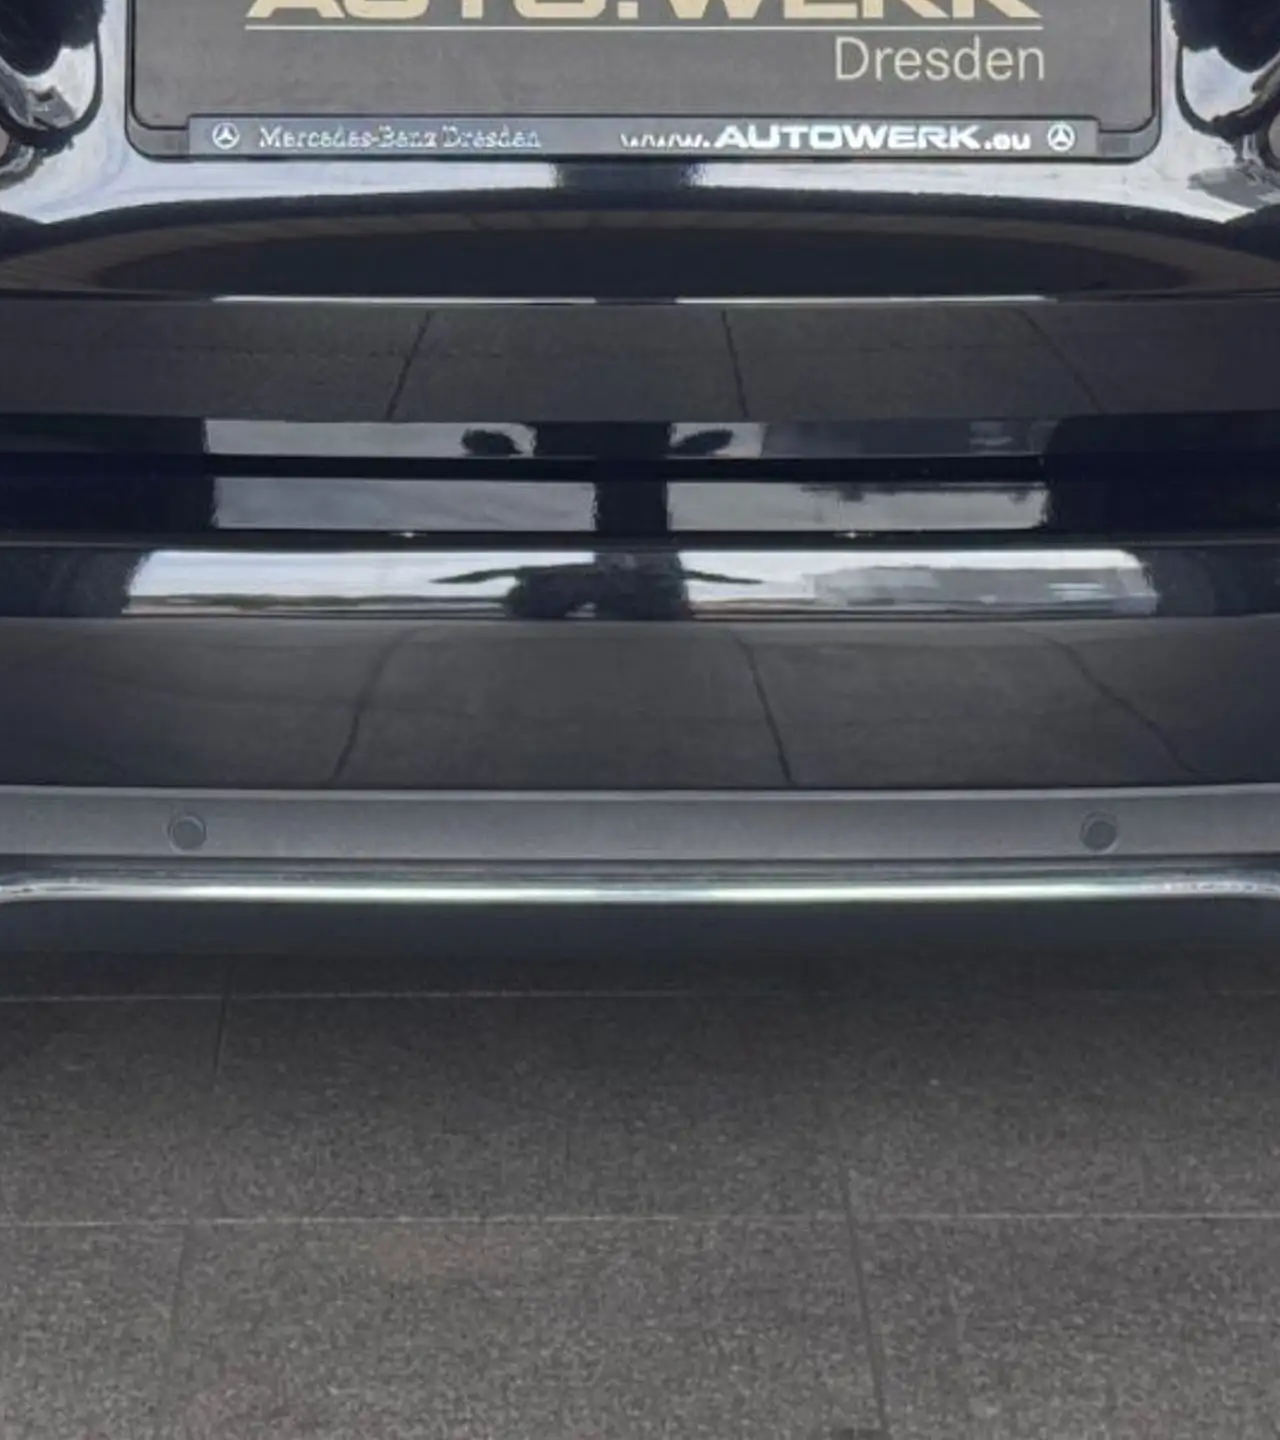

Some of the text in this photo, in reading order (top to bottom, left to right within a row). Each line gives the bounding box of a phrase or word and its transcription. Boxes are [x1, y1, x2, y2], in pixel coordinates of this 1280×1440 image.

[834, 35, 1046, 81] Dresden
[259, 124, 542, 149] Mercedes-Benz Dresden
[619, 123, 1033, 151] www.AUTOWERK.eu
